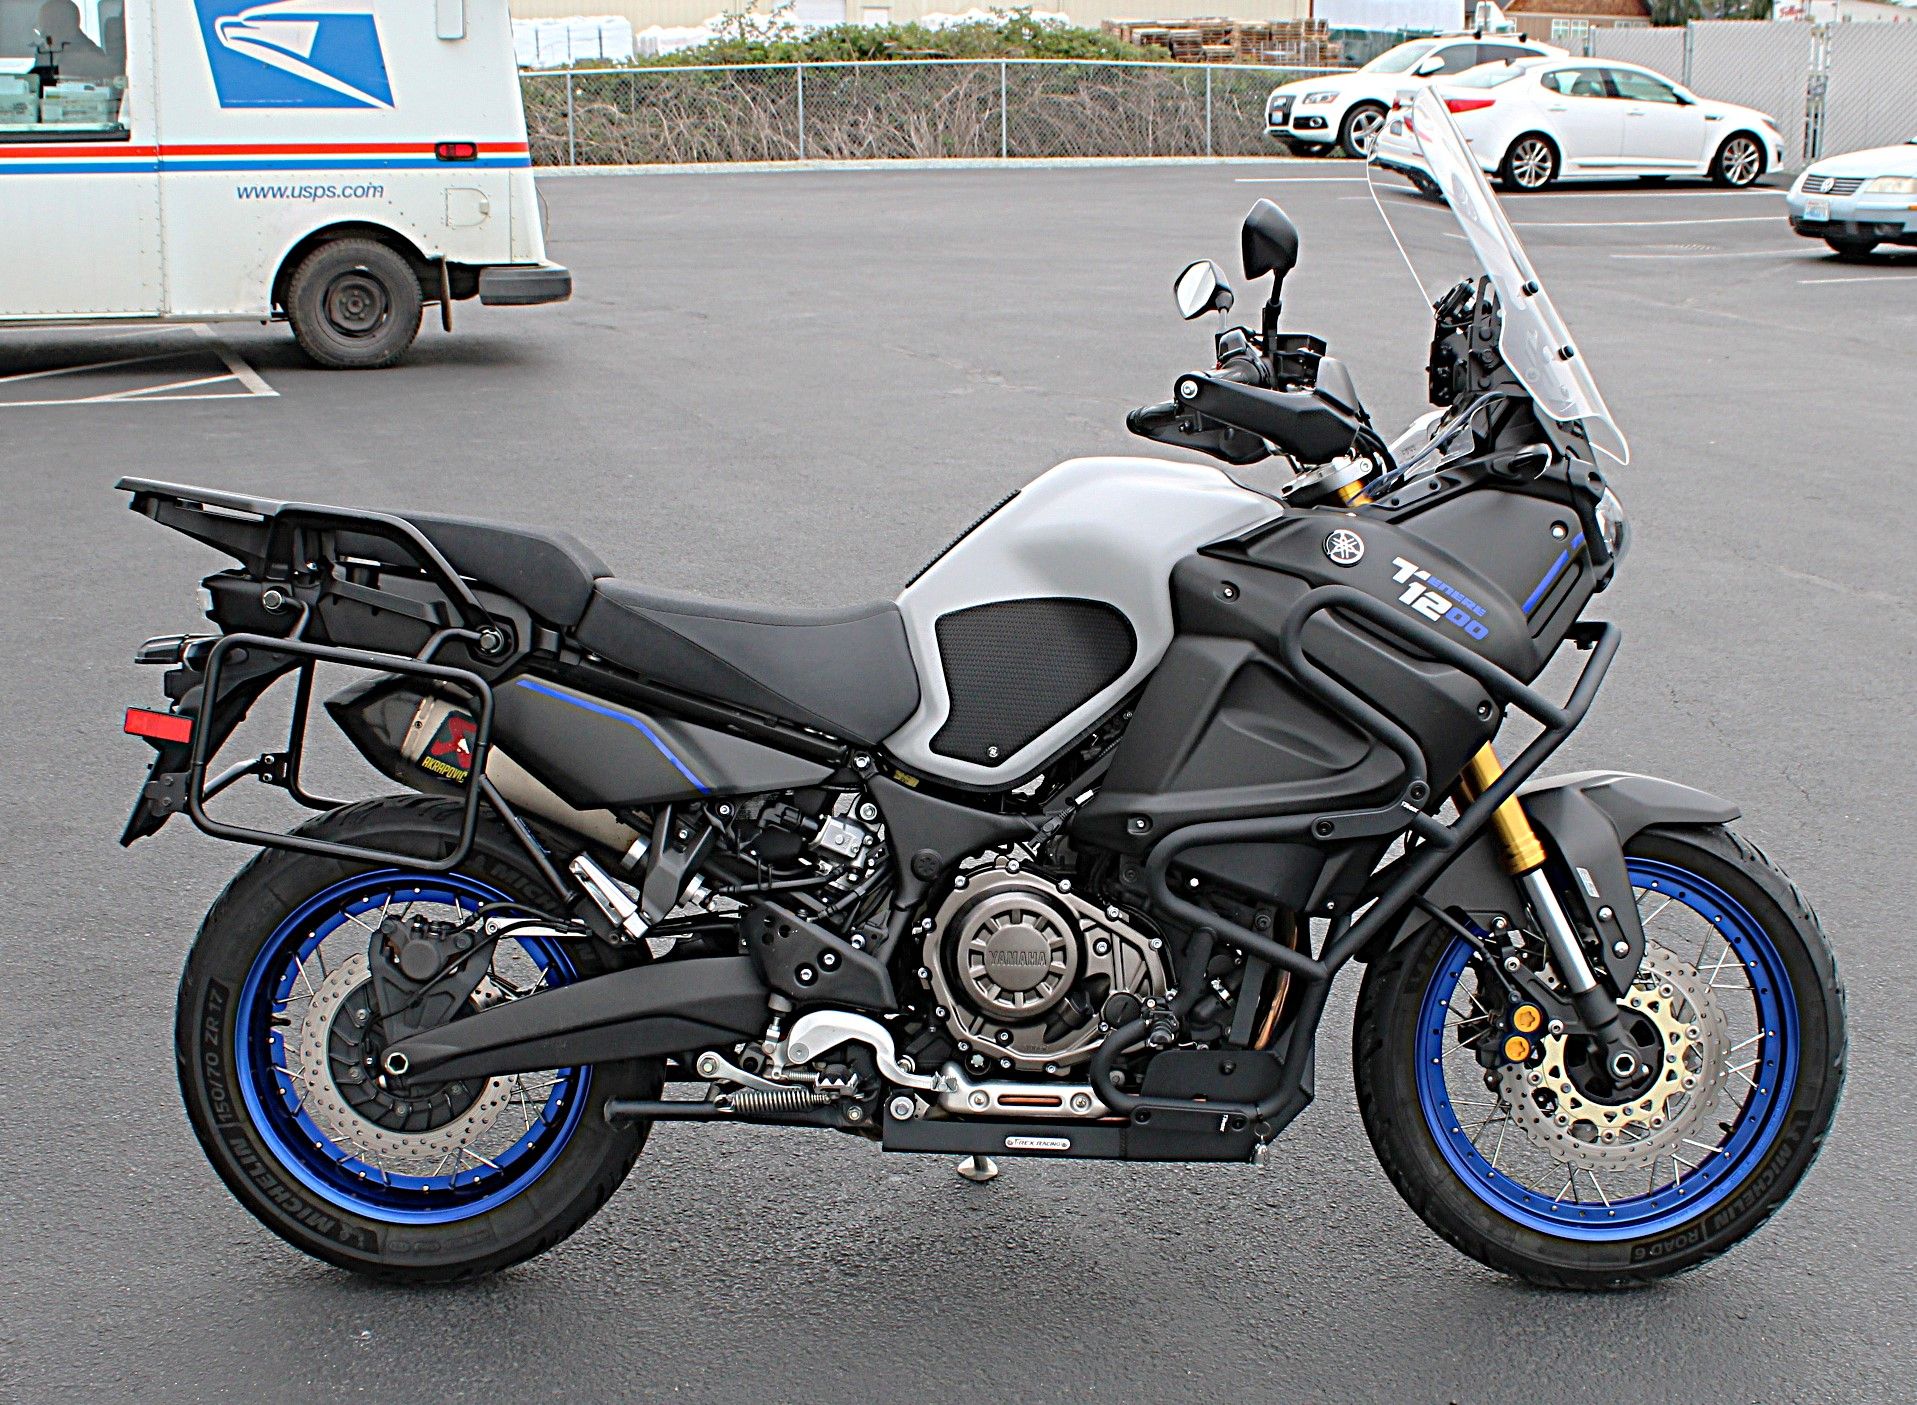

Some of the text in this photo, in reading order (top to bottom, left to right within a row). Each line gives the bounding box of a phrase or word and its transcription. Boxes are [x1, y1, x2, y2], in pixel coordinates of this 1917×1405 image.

[237, 184, 384, 202] www.usps.com
[1398, 581, 1489, 640] 1200
[989, 951, 1047, 967] YAMAHA
[204, 989, 233, 1122] 150/70 ZR 17
[229, 1138, 338, 1233] MICHELIN
[1634, 1142, 1794, 1260] MICHELIN ROAD 6
